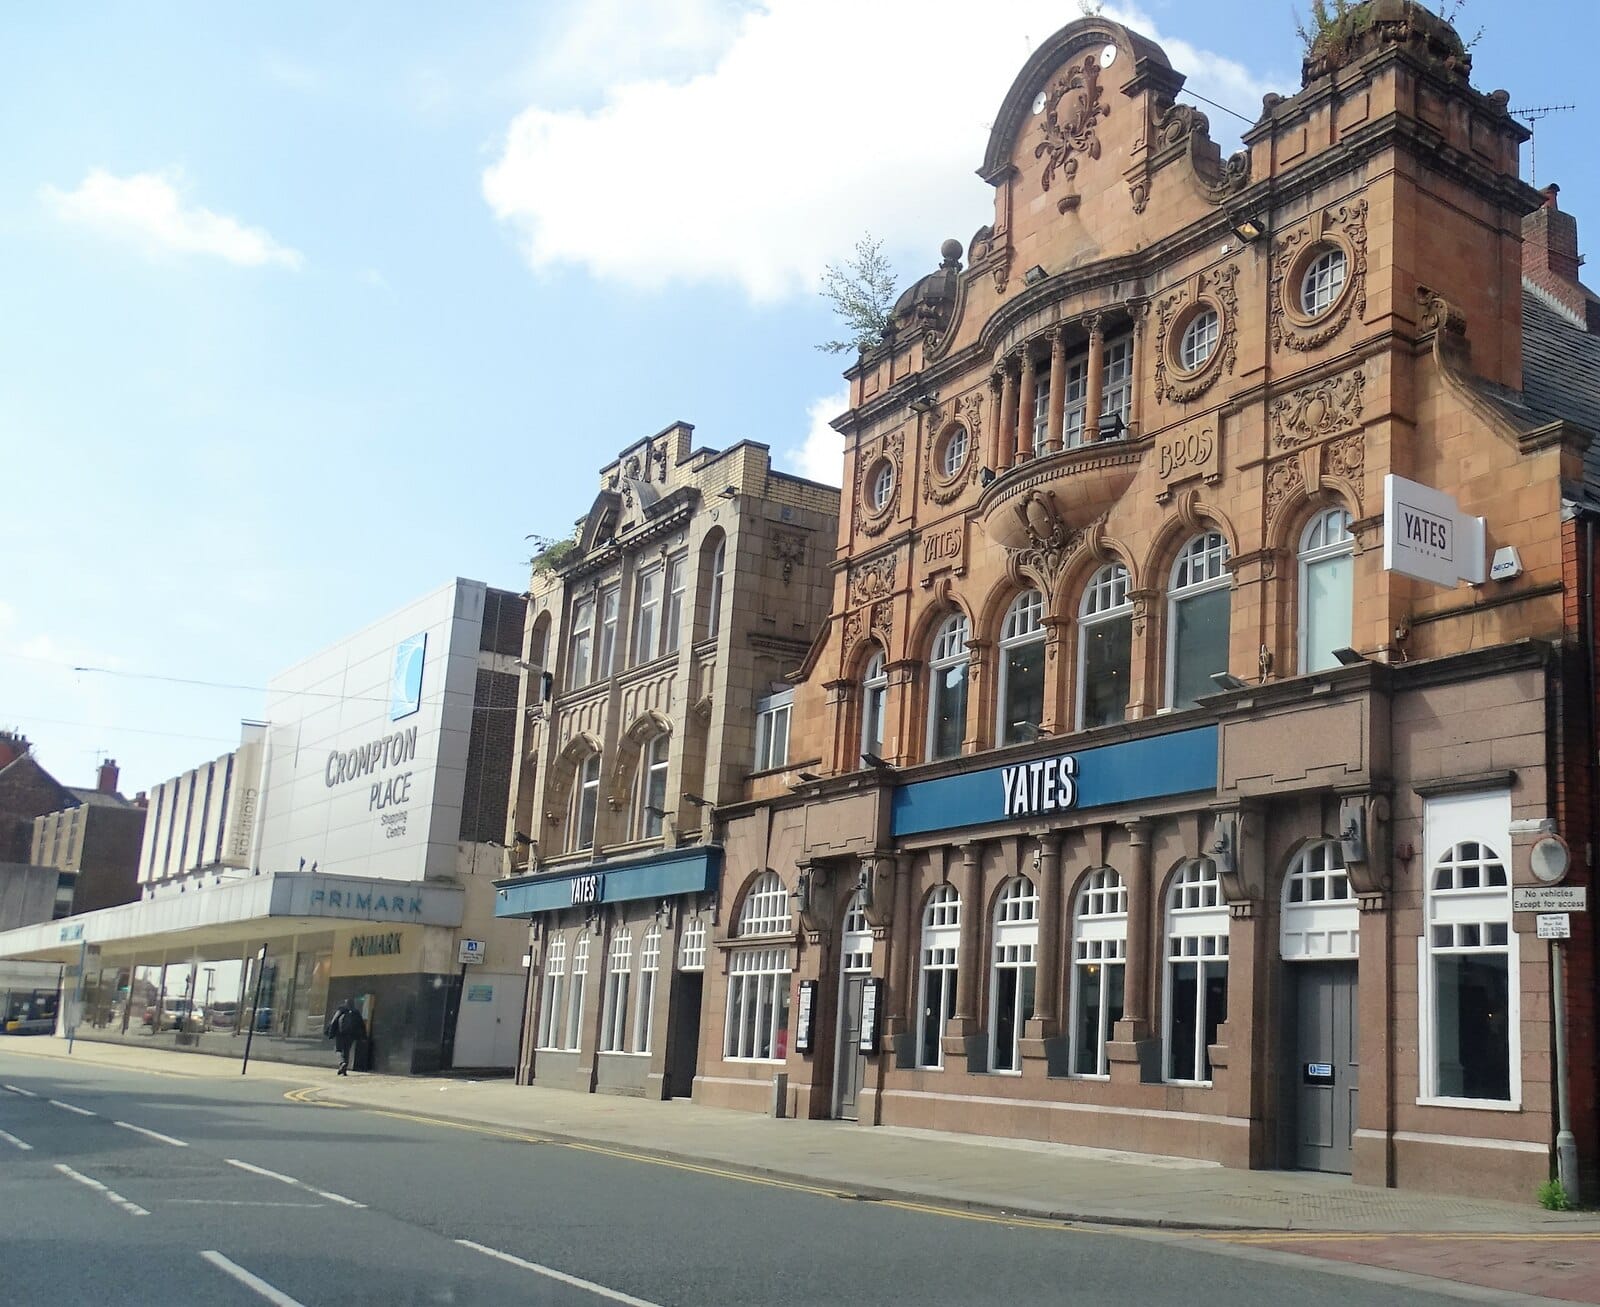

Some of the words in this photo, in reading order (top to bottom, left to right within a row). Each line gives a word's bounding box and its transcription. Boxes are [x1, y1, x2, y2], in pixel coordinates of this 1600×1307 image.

[1159, 427, 1213, 480] BROS
[922, 527, 962, 564] YATES
[1404, 511, 1446, 550] YATES
[325, 726, 417, 788] CROMPTON
[369, 771, 413, 812] PLACE
[1002, 755, 1077, 816] YATES
[311, 889, 423, 914] PRIMARK
[571, 874, 597, 905] YATES
[1514, 900, 1541, 909] Except
[1525, 890, 1537, 898] No
[349, 932, 403, 957] PRIMARK
